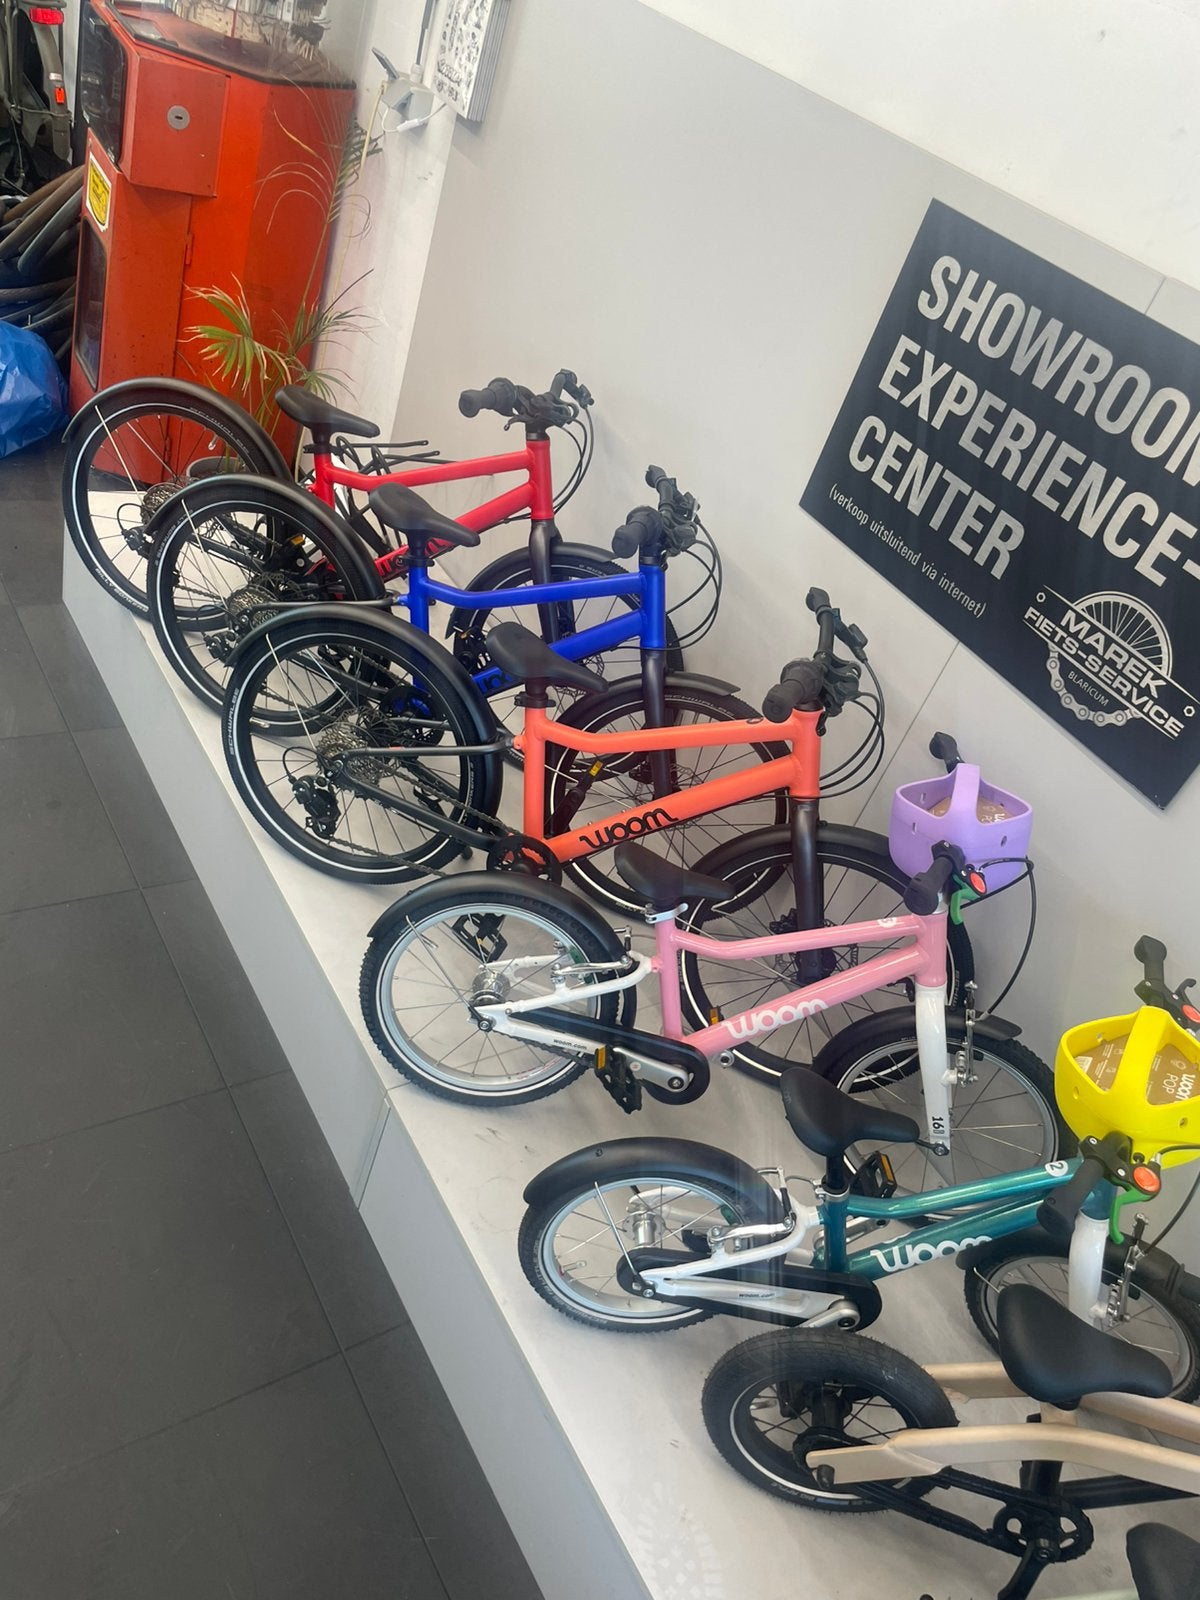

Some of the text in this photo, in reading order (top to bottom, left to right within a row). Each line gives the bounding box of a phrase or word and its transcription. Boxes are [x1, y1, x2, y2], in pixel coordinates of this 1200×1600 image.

[848, 415, 1025, 580] CENTER
[828, 483, 988, 619] (verkoop uitsluitend via internet)
[1024, 606, 1185, 738] FIETS-SERVICE
[1060, 609, 1166, 698] MAREK
[229, 687, 240, 756] SCHWALBE
[1067, 671, 1109, 707] BLARICUM
[578, 807, 679, 849] woom
[723, 998, 829, 1039] woom
[1162, 1073, 1179, 1094] POP
